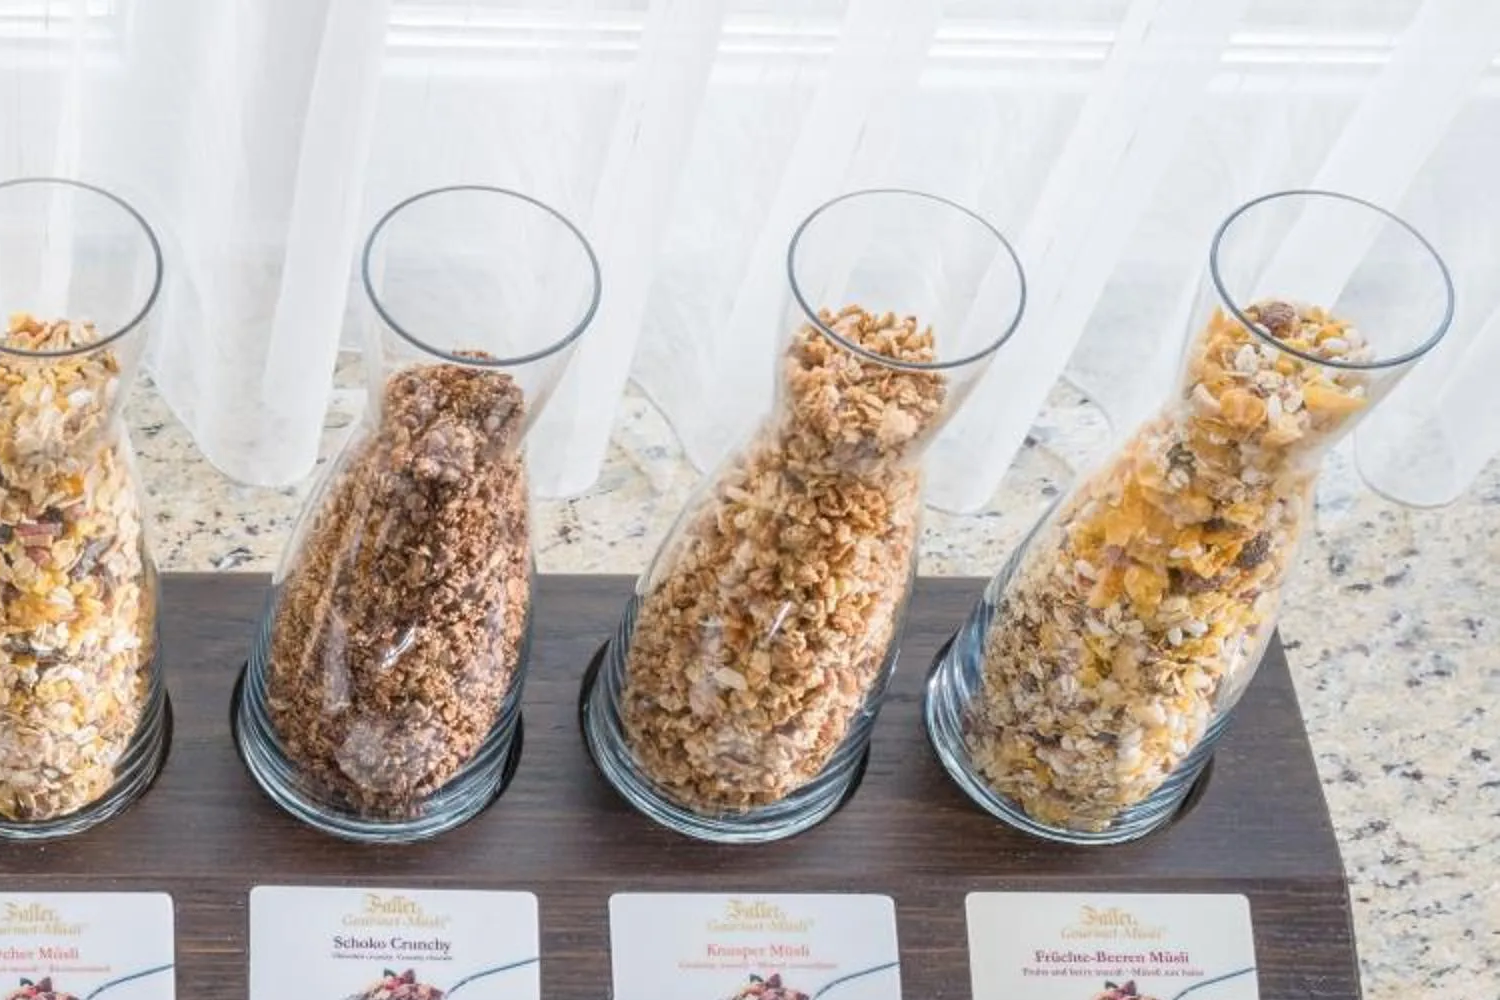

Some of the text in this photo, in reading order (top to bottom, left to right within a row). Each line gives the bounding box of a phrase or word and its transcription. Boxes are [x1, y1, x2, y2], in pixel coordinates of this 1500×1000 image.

[333, 935, 452, 954] Schoko Crunchy
[1035, 949, 1189, 963] Früchte-Beeren Müsli
